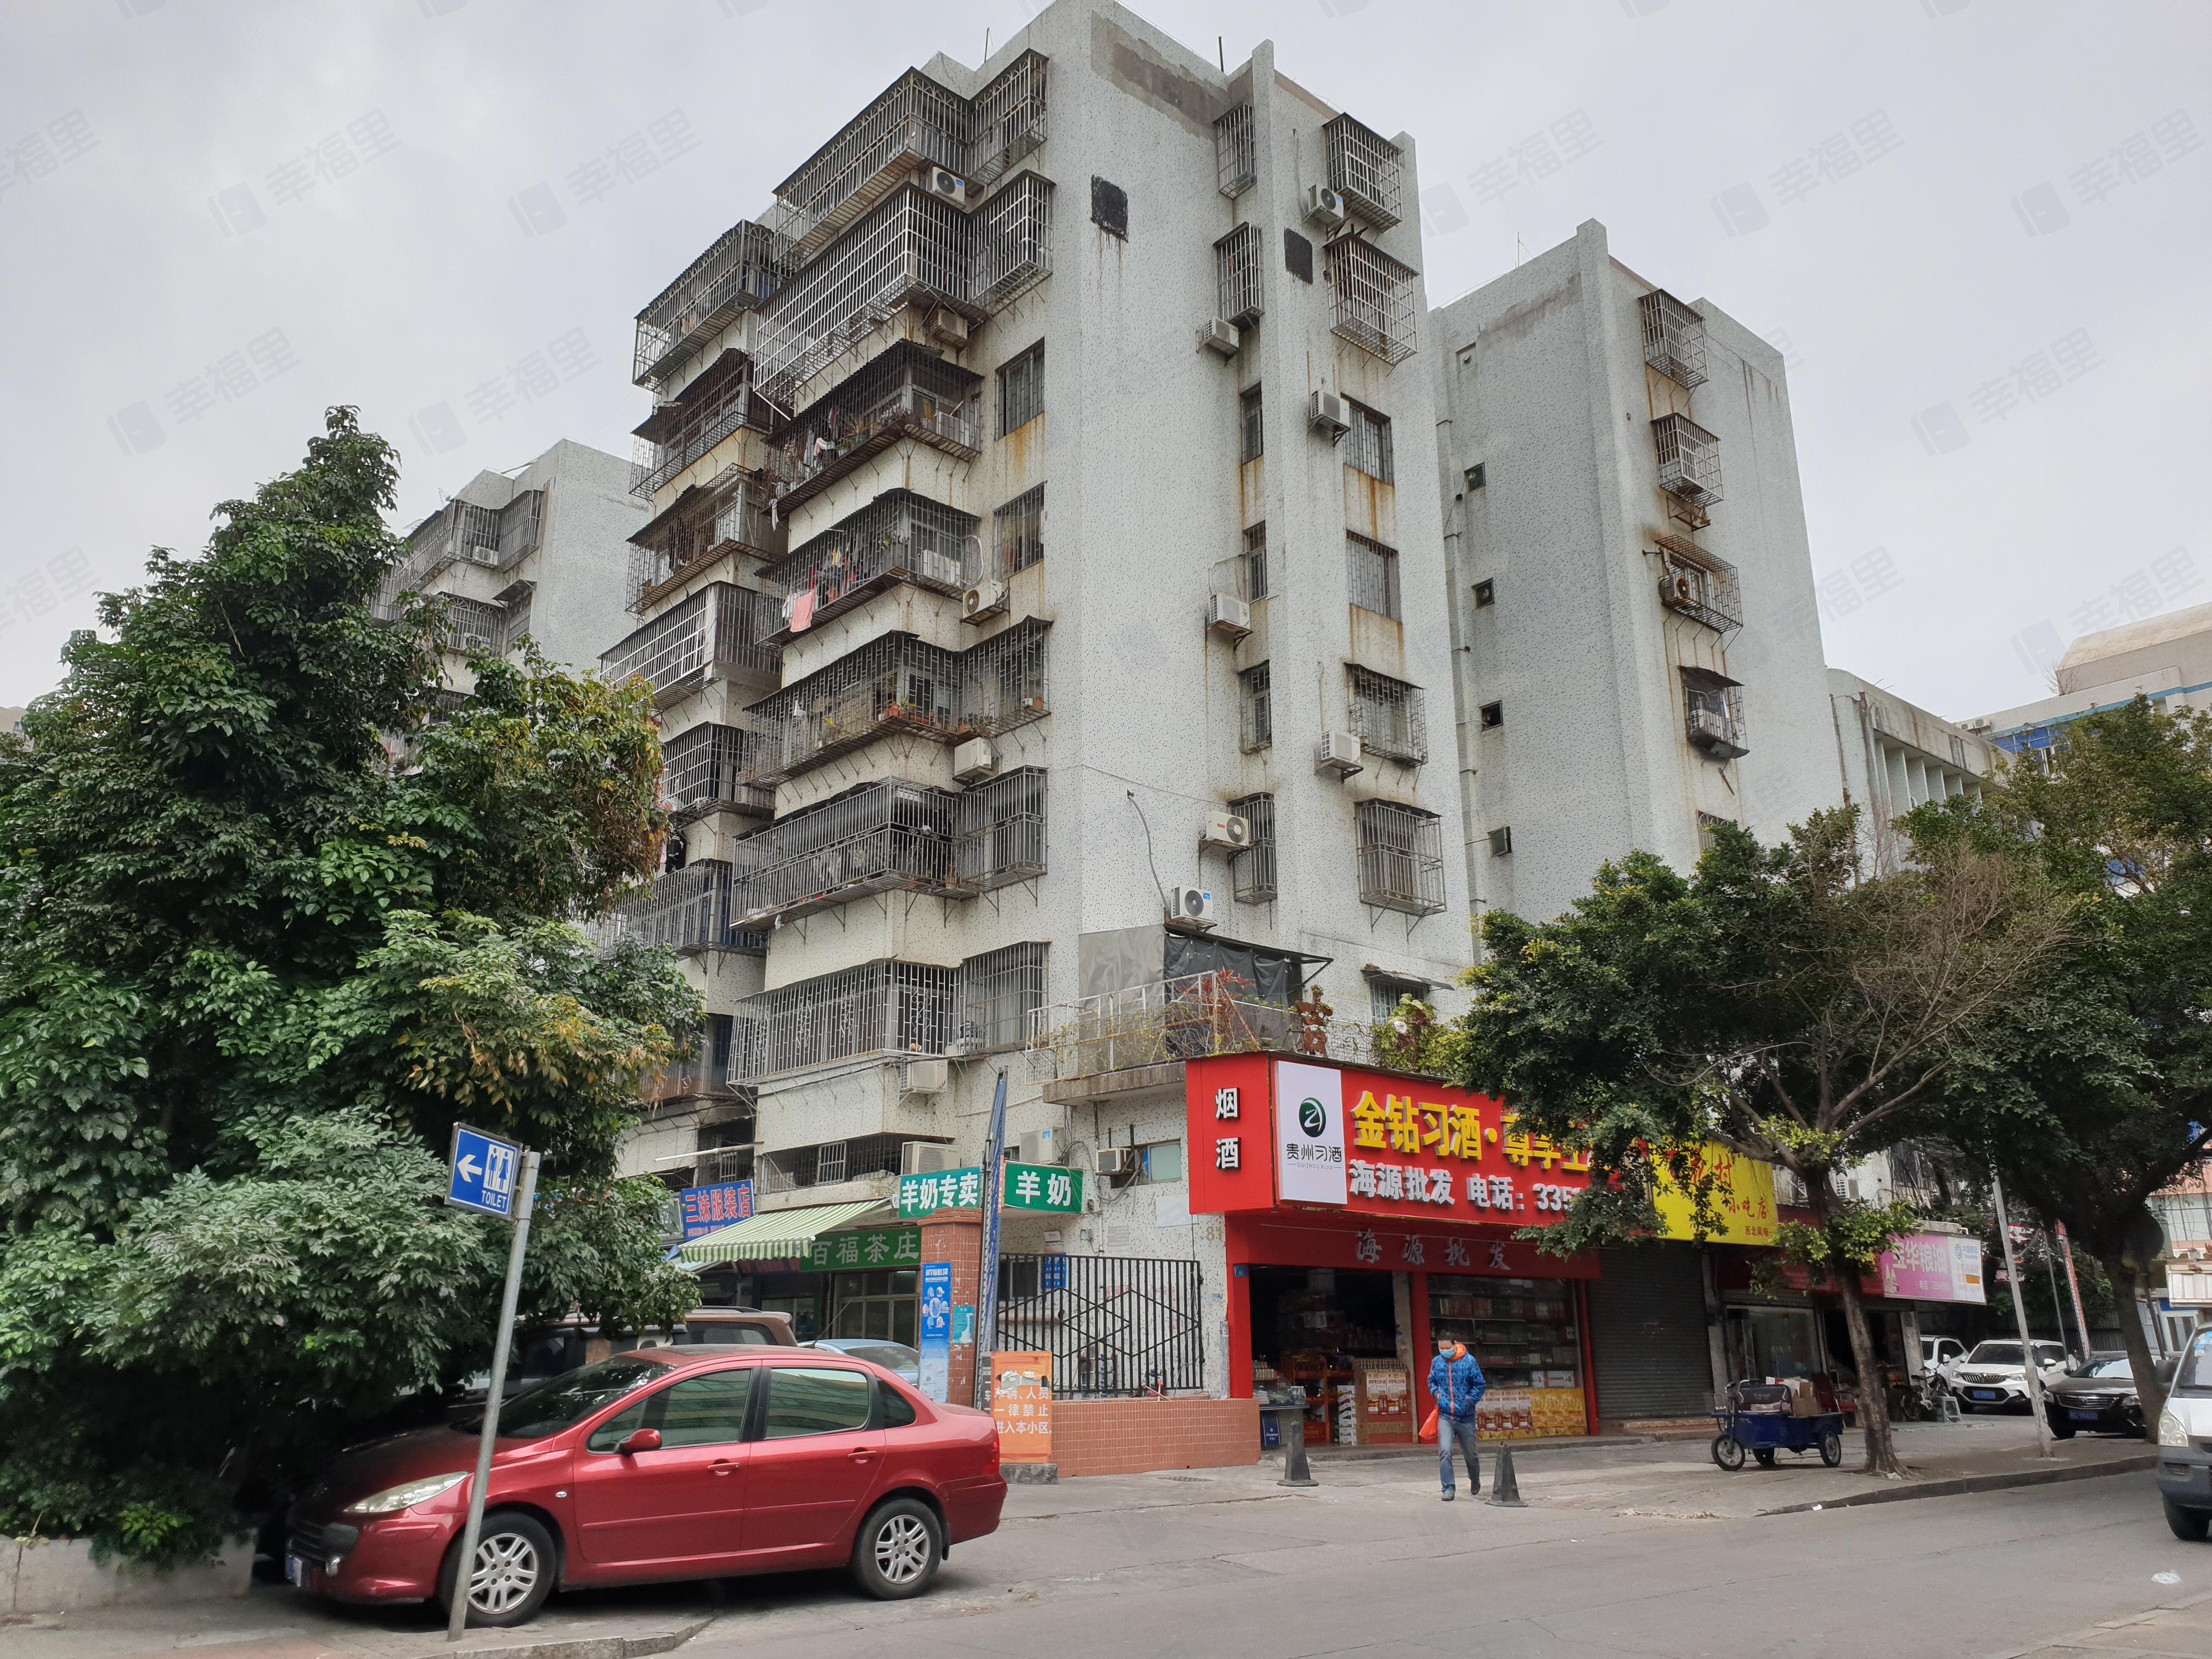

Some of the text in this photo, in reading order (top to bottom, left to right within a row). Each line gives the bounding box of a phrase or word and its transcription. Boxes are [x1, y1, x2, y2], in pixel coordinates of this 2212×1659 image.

[1286, 1143, 1342, 1163] 贵州习酒
[481, 1189, 507, 1209] TOILET
[901, 1172, 979, 1212] 羊奶专卖
[1016, 1170, 1071, 1207] 羊奶
[1348, 1159, 1455, 1205] 海源批发
[685, 1184, 752, 1223] 三妹服装店
[1729, 1196, 1767, 1220] 小吃店
[812, 1231, 919, 1266] 百福茶庄
[1355, 1228, 1511, 1271] 海源批发
[994, 1404, 1049, 1417] 一律禁止
